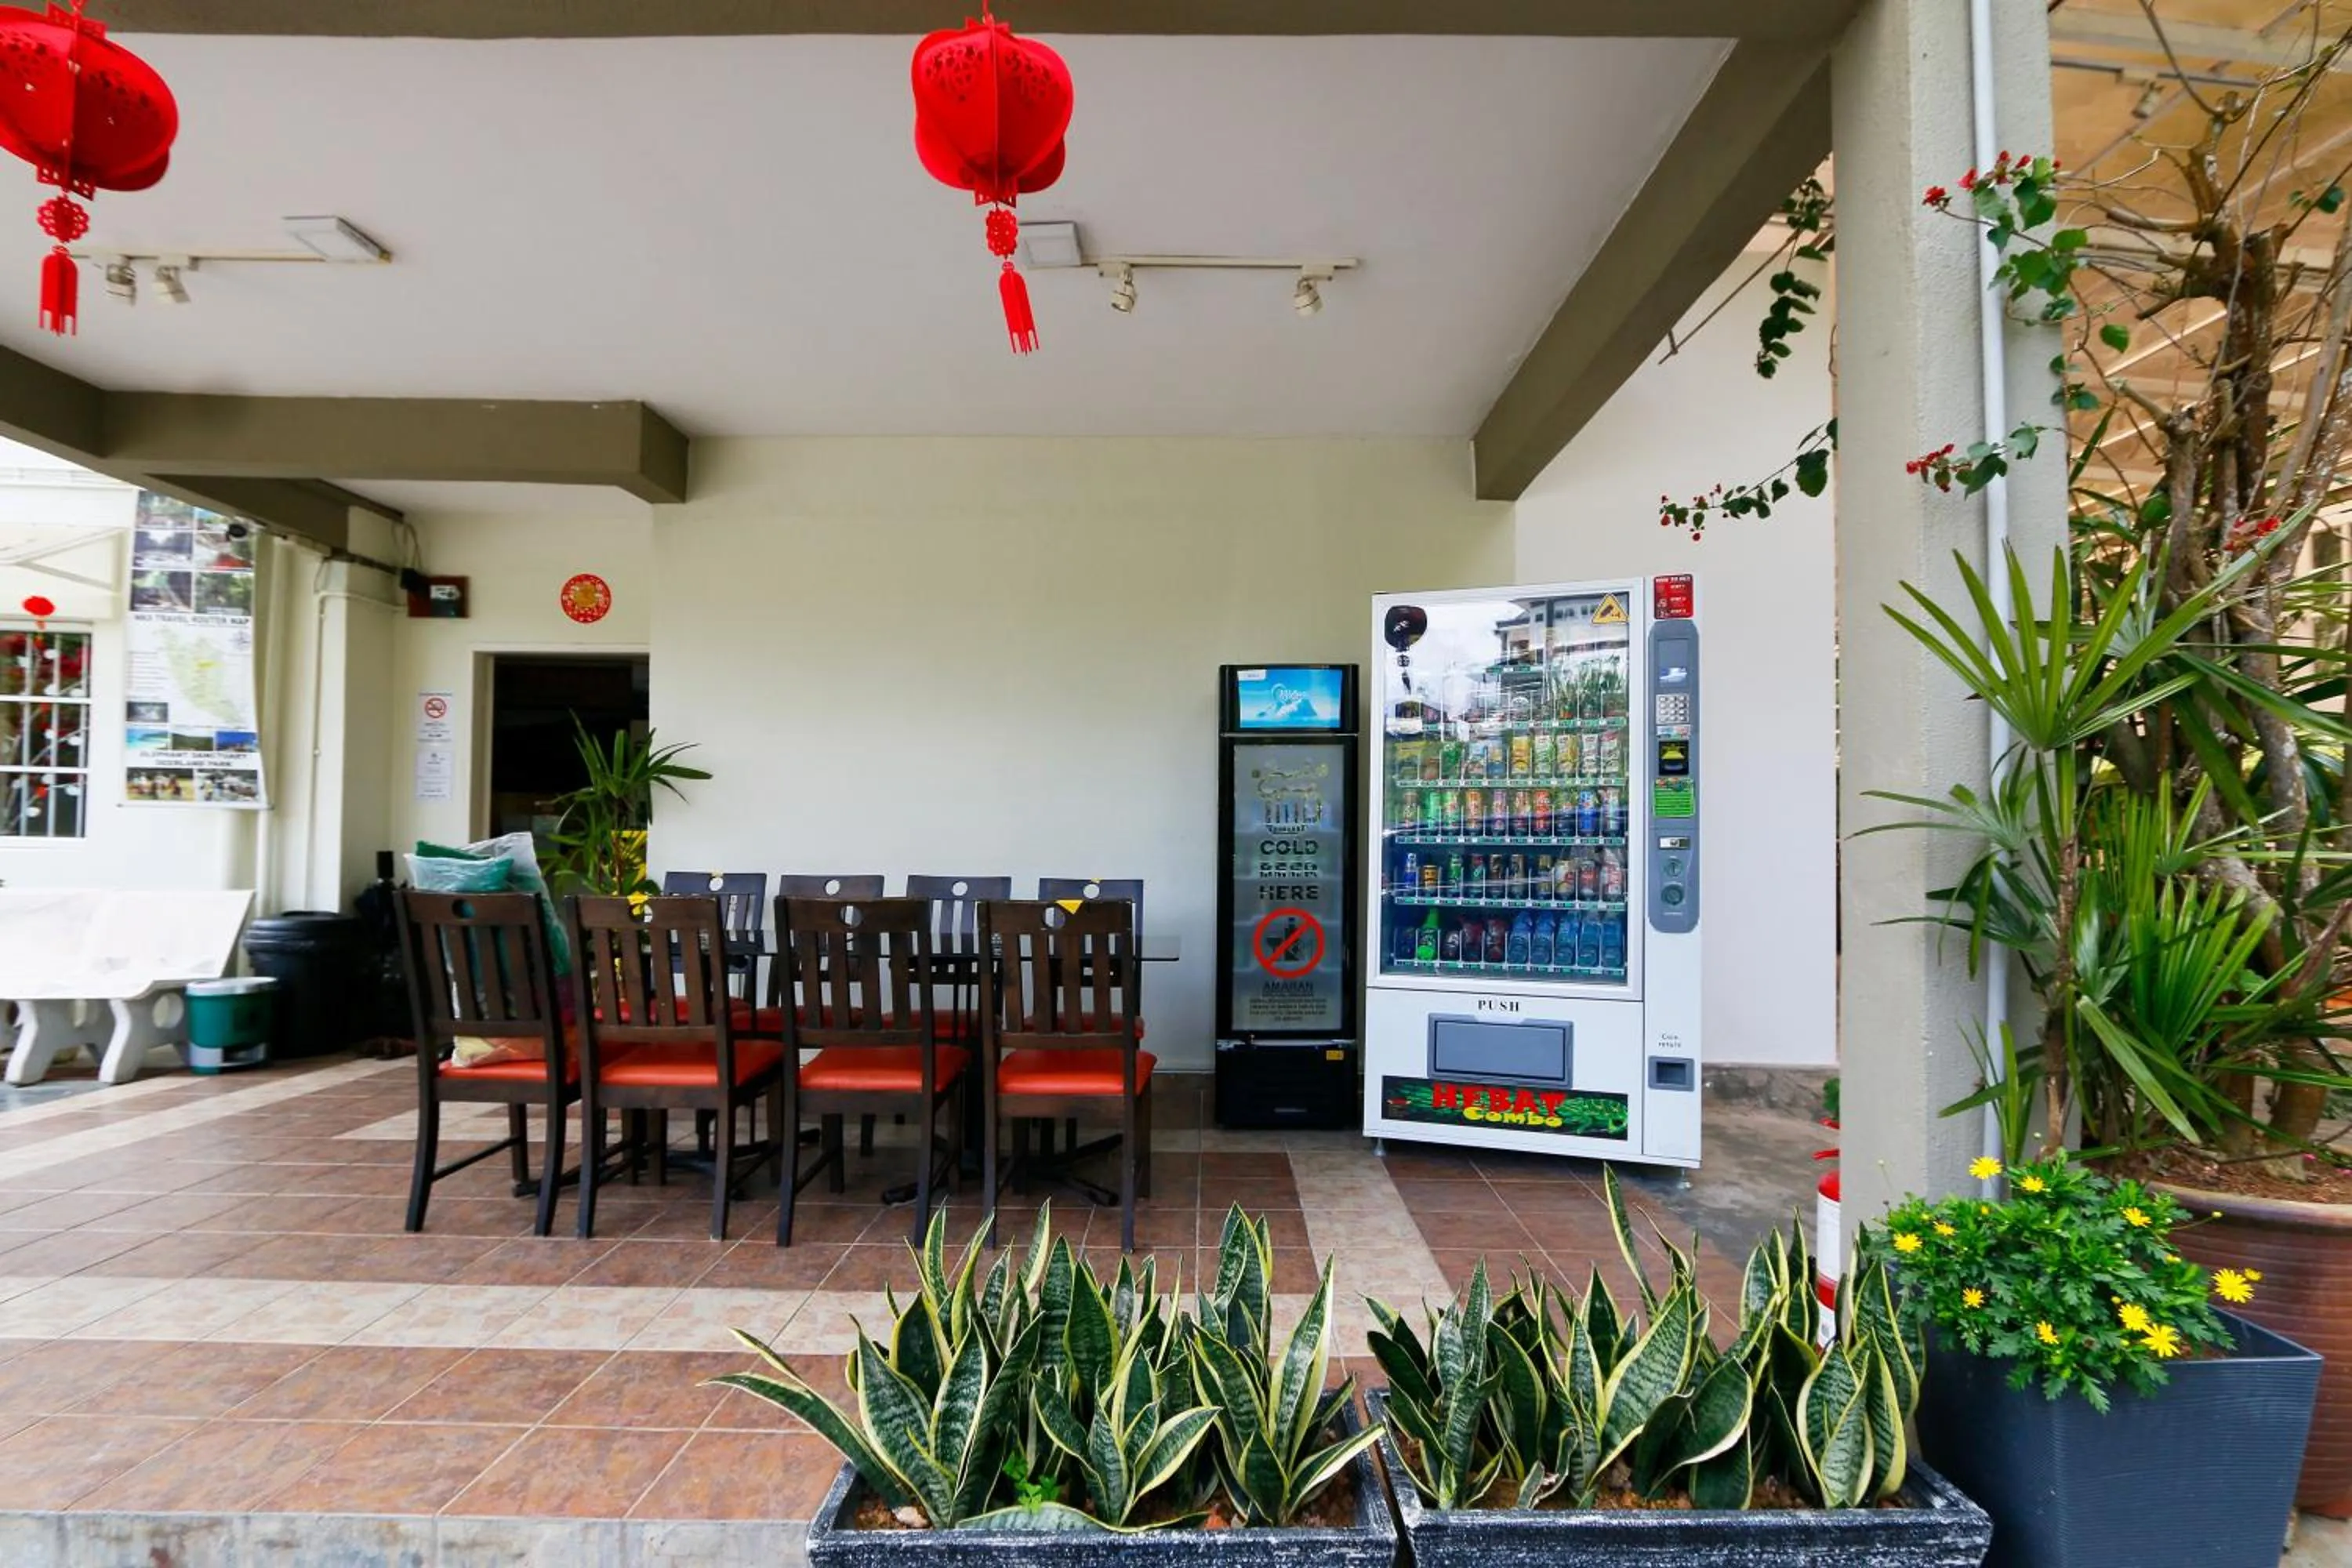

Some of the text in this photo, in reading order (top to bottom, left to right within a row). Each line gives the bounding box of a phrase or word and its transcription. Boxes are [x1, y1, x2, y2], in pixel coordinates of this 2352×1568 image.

[1260, 840, 1319, 855] COLD
[1259, 885, 1319, 900] HERE
[1478, 1000, 1519, 1011] PUSH
[1432, 1081, 1566, 1117] HEBAT
[1463, 1106, 1563, 1127] Combo
